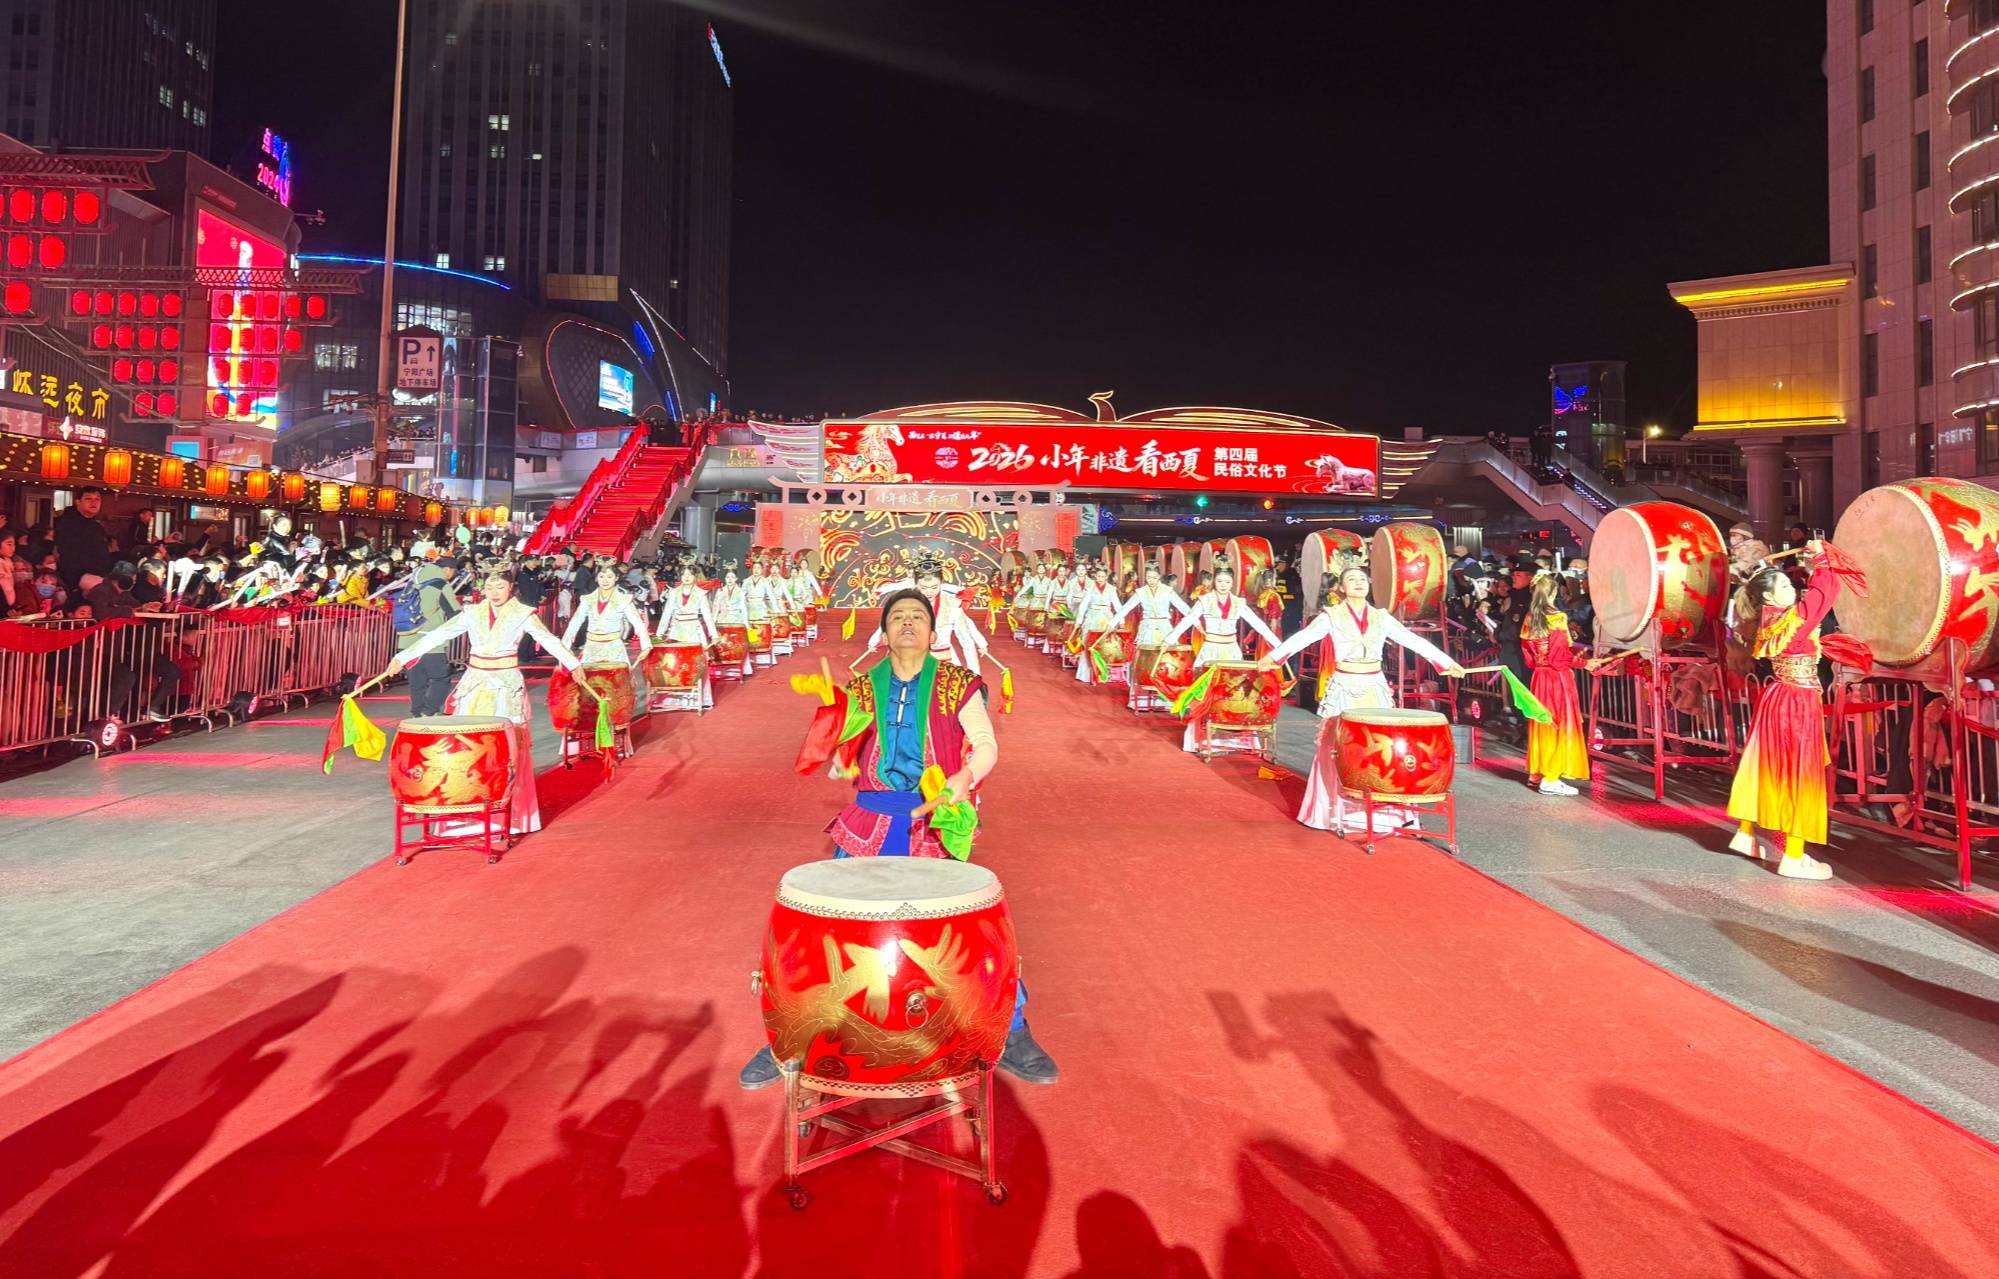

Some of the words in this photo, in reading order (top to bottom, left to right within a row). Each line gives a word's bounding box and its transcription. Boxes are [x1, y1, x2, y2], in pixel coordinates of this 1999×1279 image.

[402, 339, 422, 365] P
[400, 378, 437, 387] 地下停车场
[12, 369, 111, 420] 怀远夜市
[967, 442, 1036, 473] 2026
[1213, 446, 1259, 463] 第四届
[1213, 463, 1287, 479] 民俗文化节
